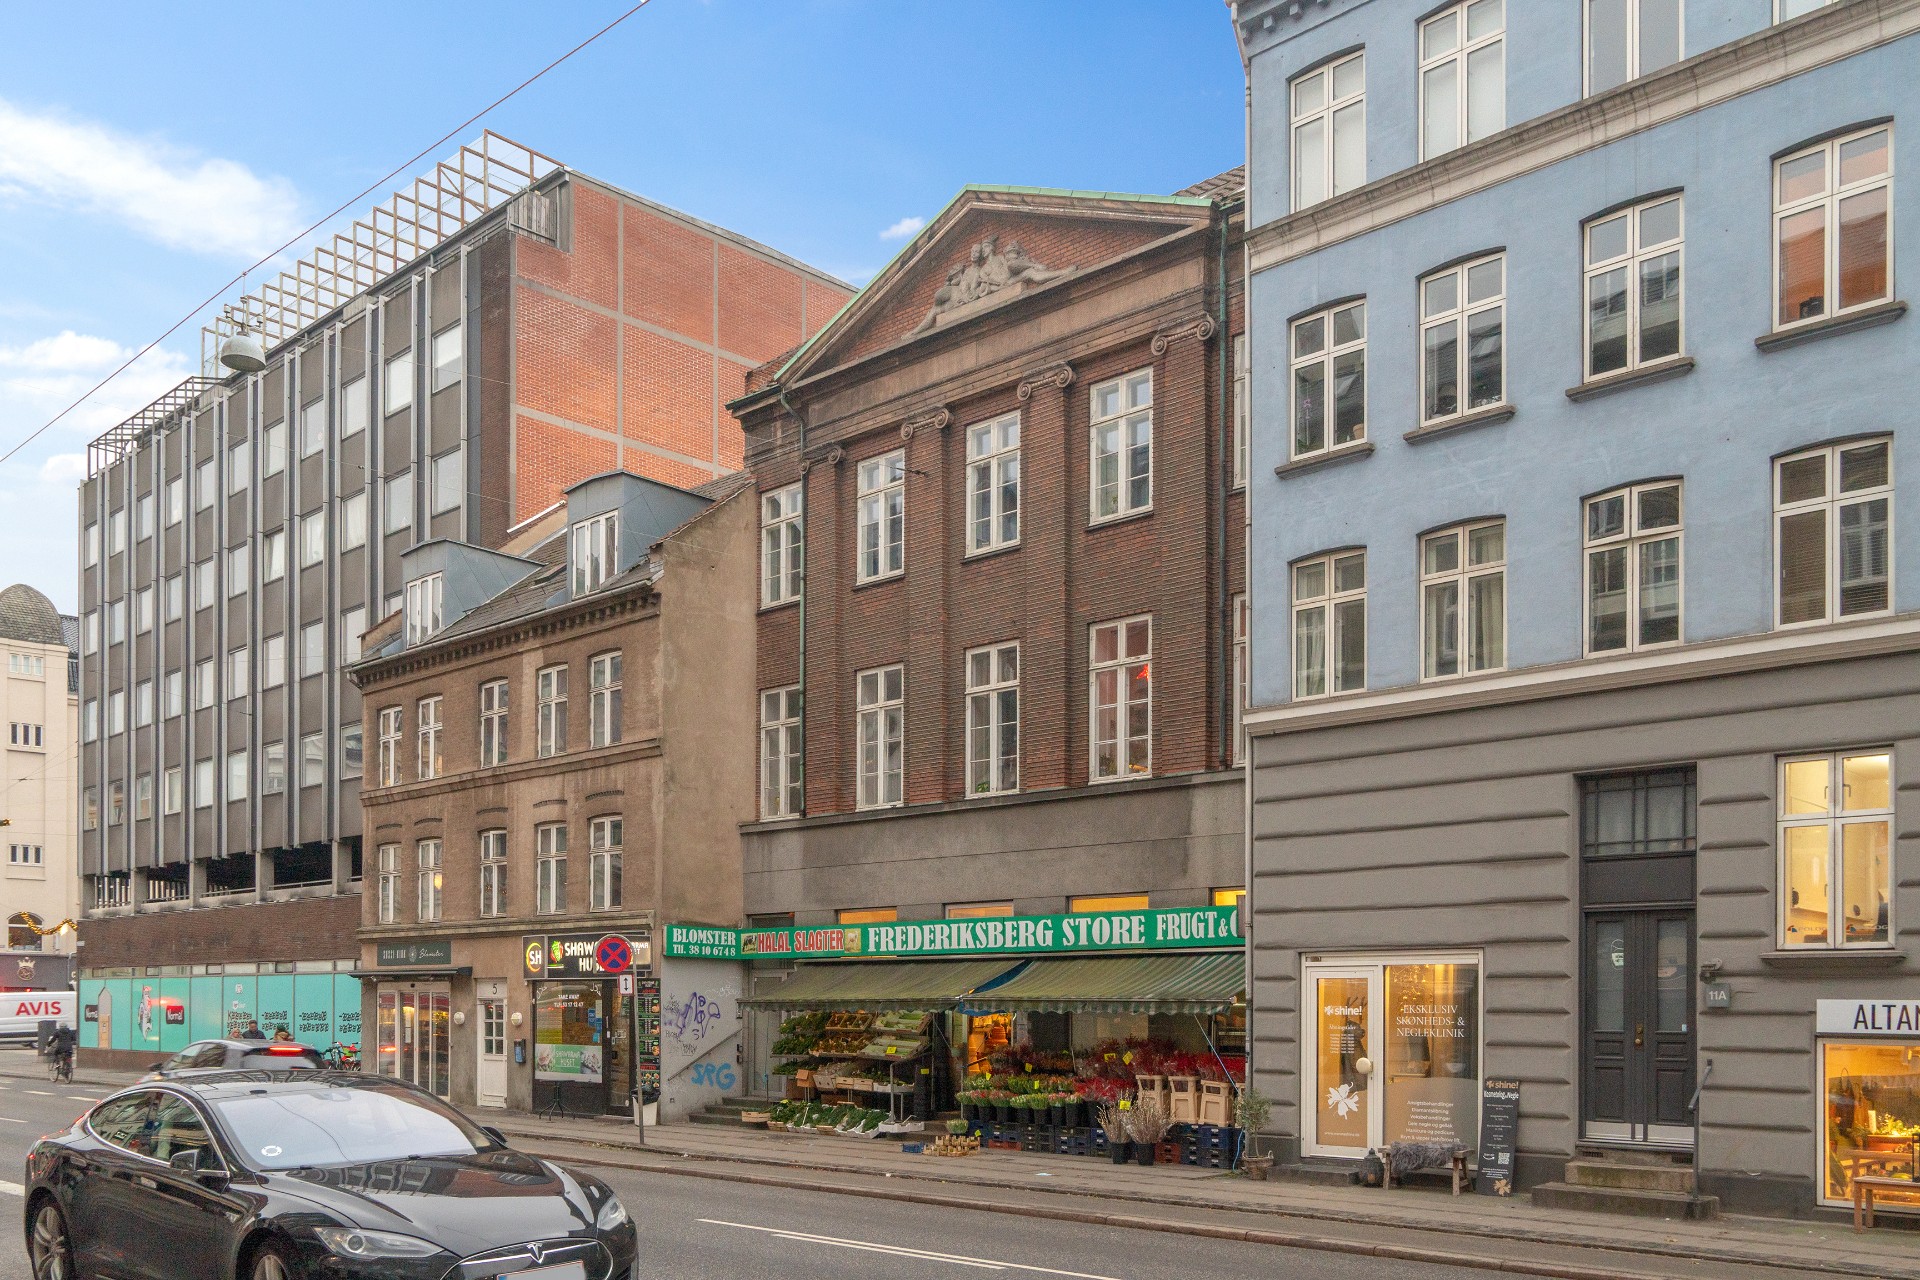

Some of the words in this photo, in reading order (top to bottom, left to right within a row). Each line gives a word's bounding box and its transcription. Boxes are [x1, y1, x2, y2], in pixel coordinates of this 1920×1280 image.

[673, 928, 737, 945] BLOMSTER
[868, 919, 1054, 952] FREDERIKSBERG
[1061, 916, 1146, 946] STORE
[1156, 912, 1217, 940] FRUGT
[1218, 923, 1228, 937] &
[758, 932, 792, 953] HALAL
[794, 929, 844, 952] SLAGTER
[564, 942, 597, 957] SHAW
[689, 946, 700, 955] 38
[702, 946, 711, 956] 10
[493, 983, 498, 995] 5
[1708, 991, 1727, 1001] 11A
[16, 1001, 62, 1016] AVIS
[1334, 1006, 1363, 1016] shine!
[1403, 1005, 1459, 1014] EKSKLUSIV
[1396, 1017, 1455, 1026] SKØNHEDS-
[1457, 1016, 1465, 1026] &
[1396, 1028, 1465, 1038] NEGLEKLINIK
[691, 1062, 737, 1091] SRG
[1495, 1081, 1519, 1089] shine!
